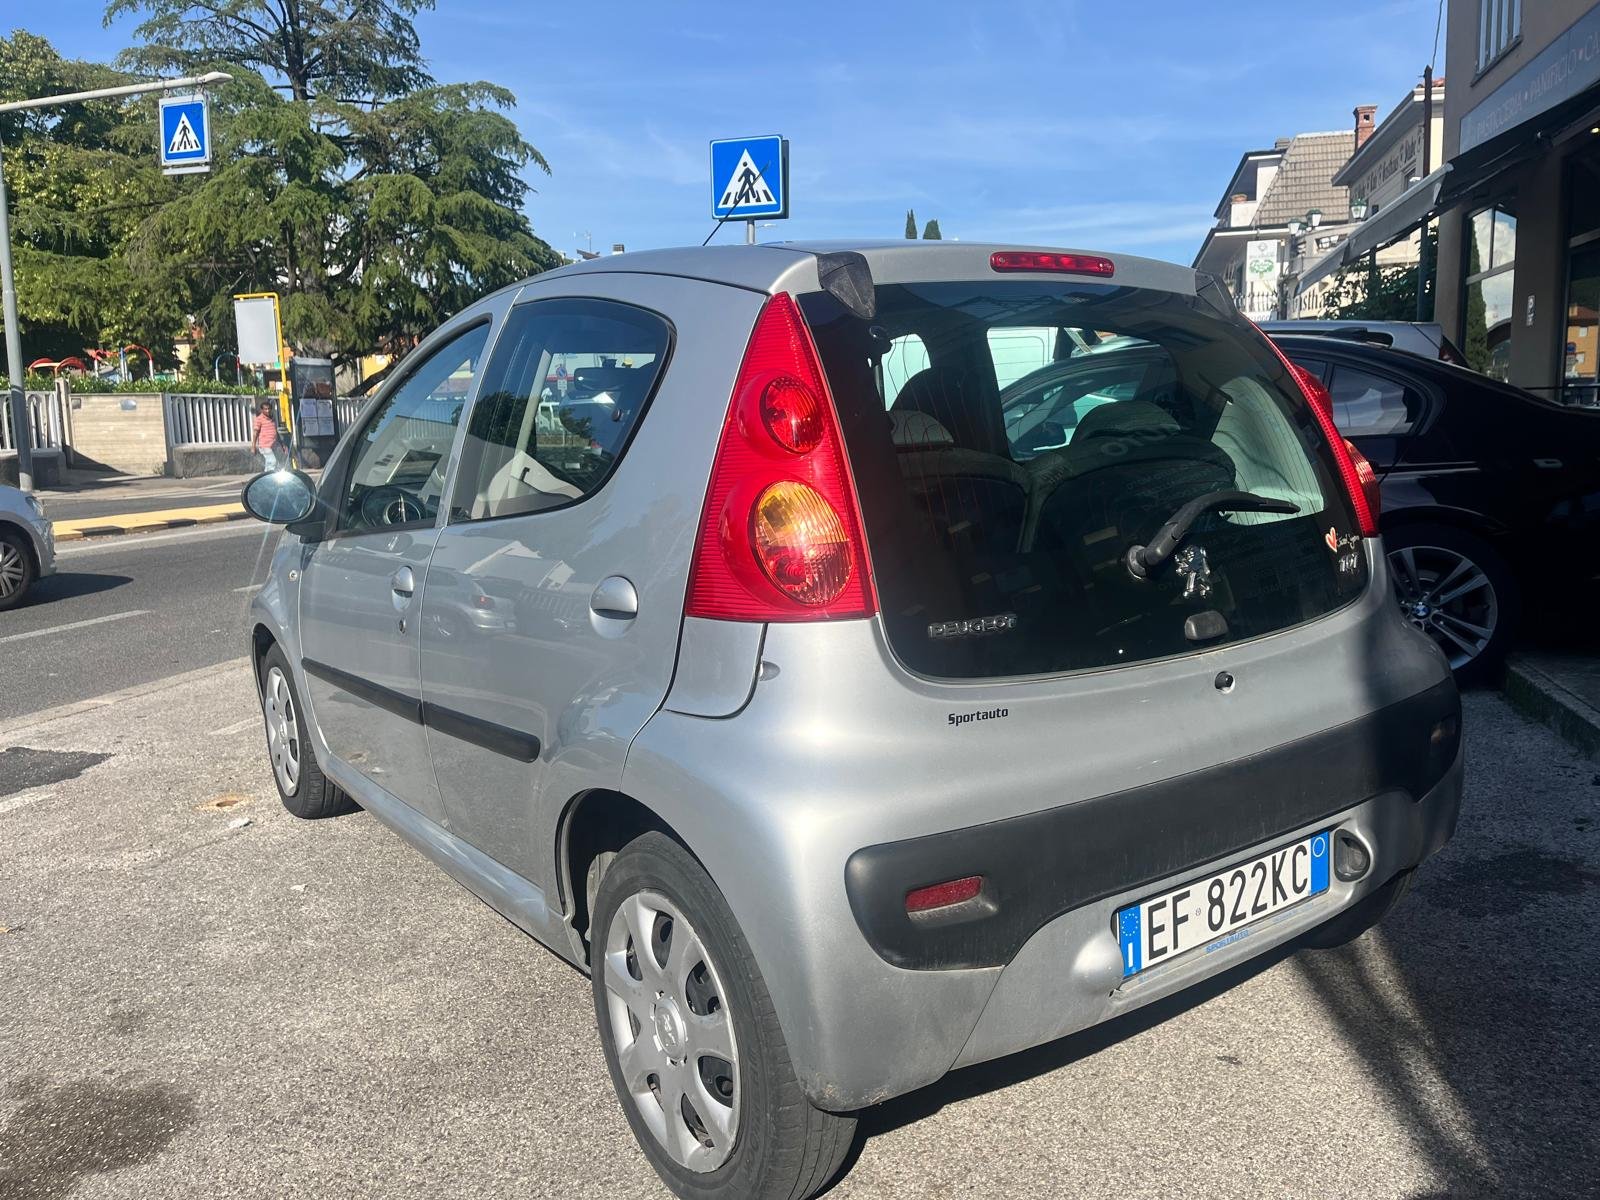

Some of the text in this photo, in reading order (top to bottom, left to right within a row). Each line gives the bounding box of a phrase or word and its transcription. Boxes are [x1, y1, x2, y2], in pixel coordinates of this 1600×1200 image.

[928, 614, 1017, 639] PEUGEOT
[948, 708, 1009, 726] Sportauto
[1148, 844, 1308, 961] EF 822KC
